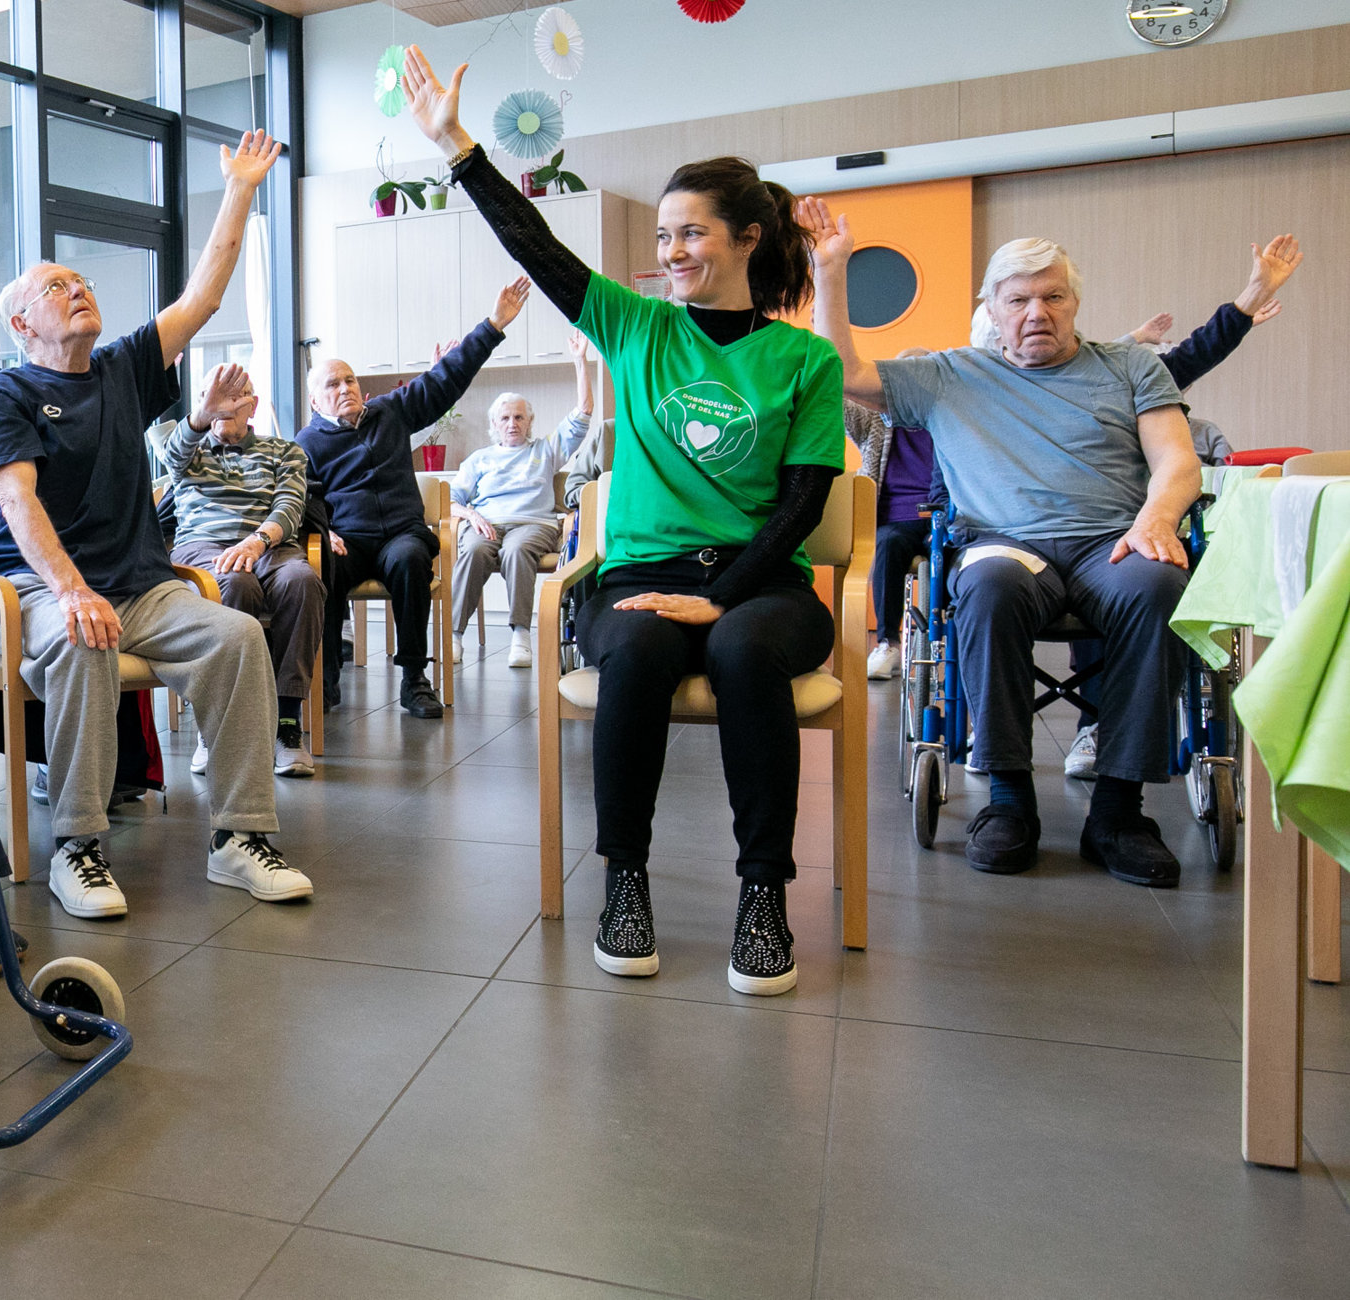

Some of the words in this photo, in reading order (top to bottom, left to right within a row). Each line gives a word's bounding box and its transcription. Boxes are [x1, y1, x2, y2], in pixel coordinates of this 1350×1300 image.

[1199, 7, 1208, 17] 4
[1146, 17, 1155, 27] 8
[1189, 18, 1198, 29] 5
[1158, 24, 1166, 34] 7
[1172, 25, 1182, 35] 6
[682, 393, 742, 413] DOBRODELNOST
[698, 406, 712, 415] DEL
[714, 410, 732, 419] NAS.
